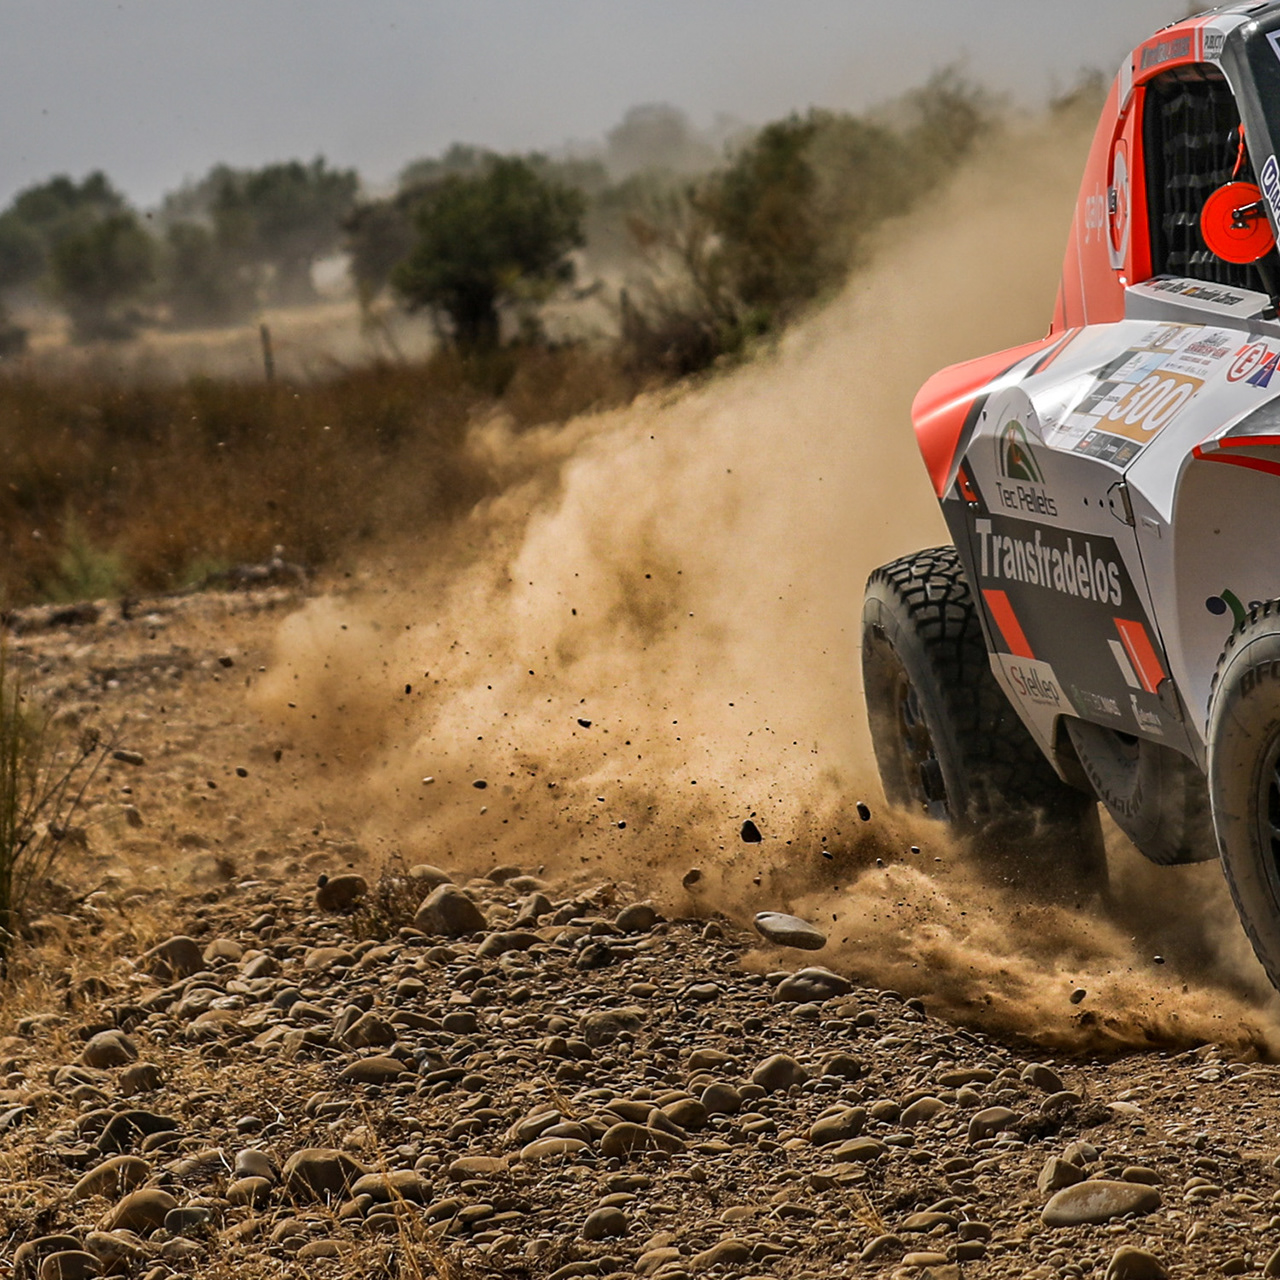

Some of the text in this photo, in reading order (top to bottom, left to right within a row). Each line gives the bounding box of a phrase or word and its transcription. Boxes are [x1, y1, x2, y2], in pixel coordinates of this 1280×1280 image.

[1108, 375, 1194, 431] 300
[996, 481, 1058, 517] Tec Pellets
[975, 518, 1122, 607] Transfradelos
